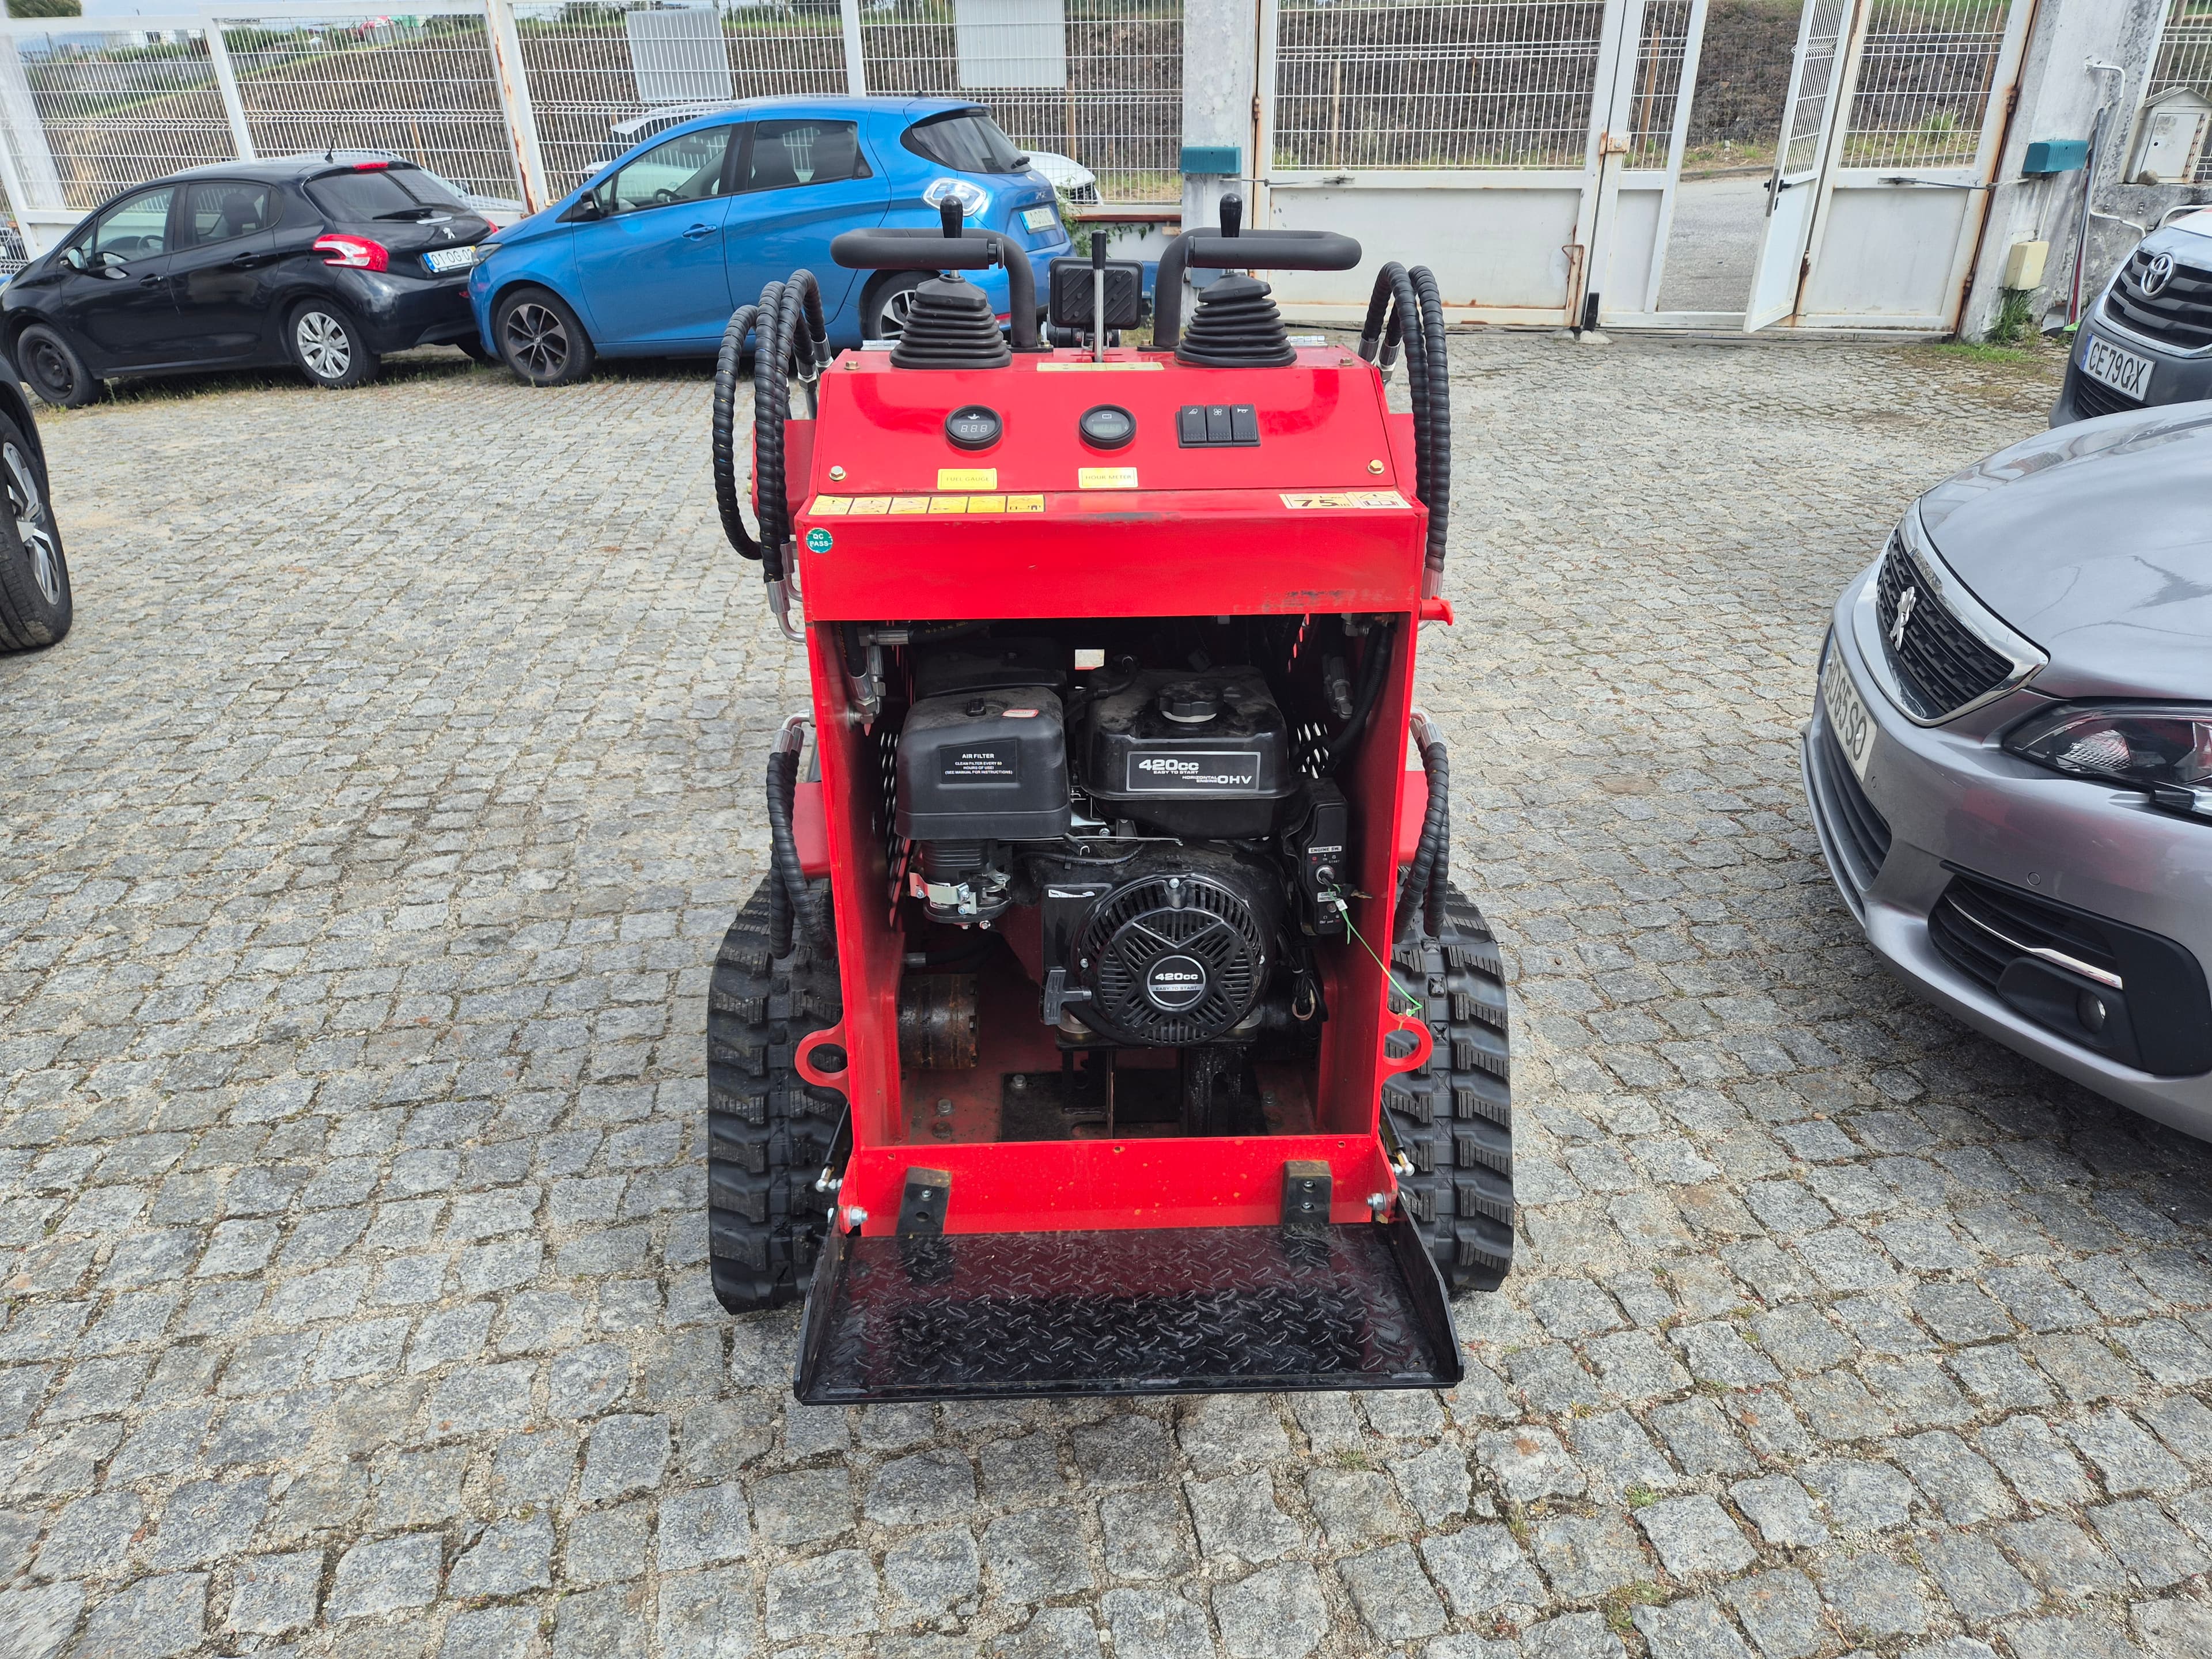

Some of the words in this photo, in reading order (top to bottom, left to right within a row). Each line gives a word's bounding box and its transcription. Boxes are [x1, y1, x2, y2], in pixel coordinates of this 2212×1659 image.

[2089, 341, 2147, 394] CE79QX
[1138, 759, 1199, 771] 420cc
[1217, 775, 1252, 784] OHV
[1155, 972, 1198, 980] 420cc
